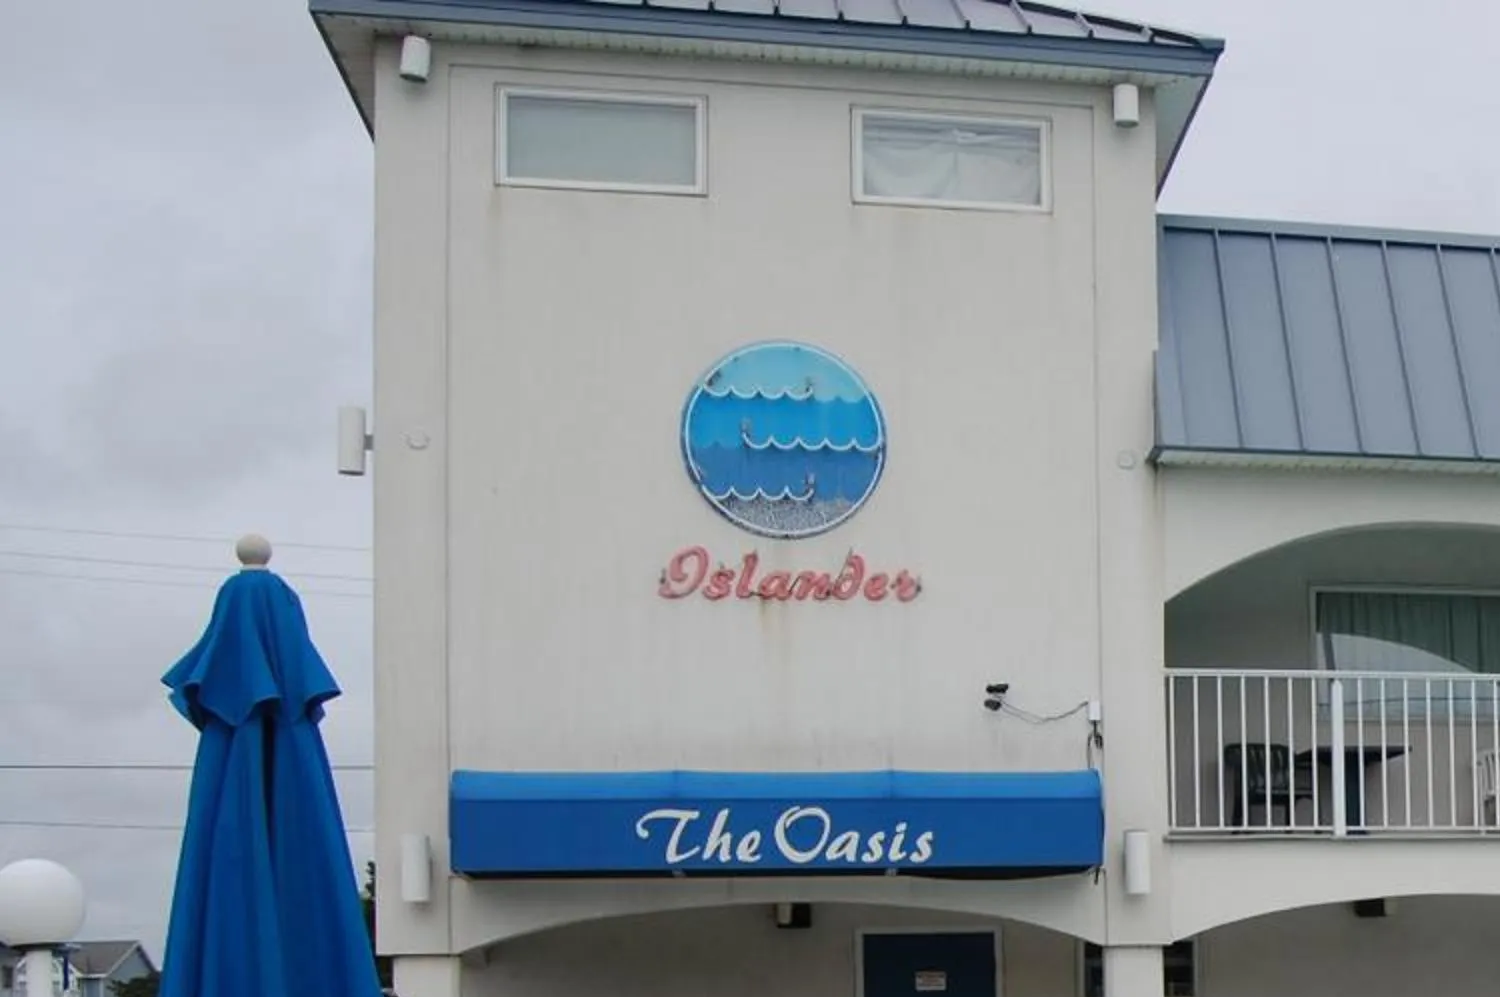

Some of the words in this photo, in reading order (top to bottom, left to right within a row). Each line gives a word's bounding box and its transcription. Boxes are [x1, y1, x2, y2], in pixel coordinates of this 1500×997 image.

[658, 546, 922, 601] Islander
[636, 808, 761, 864] The
[774, 806, 933, 863] Oasis
